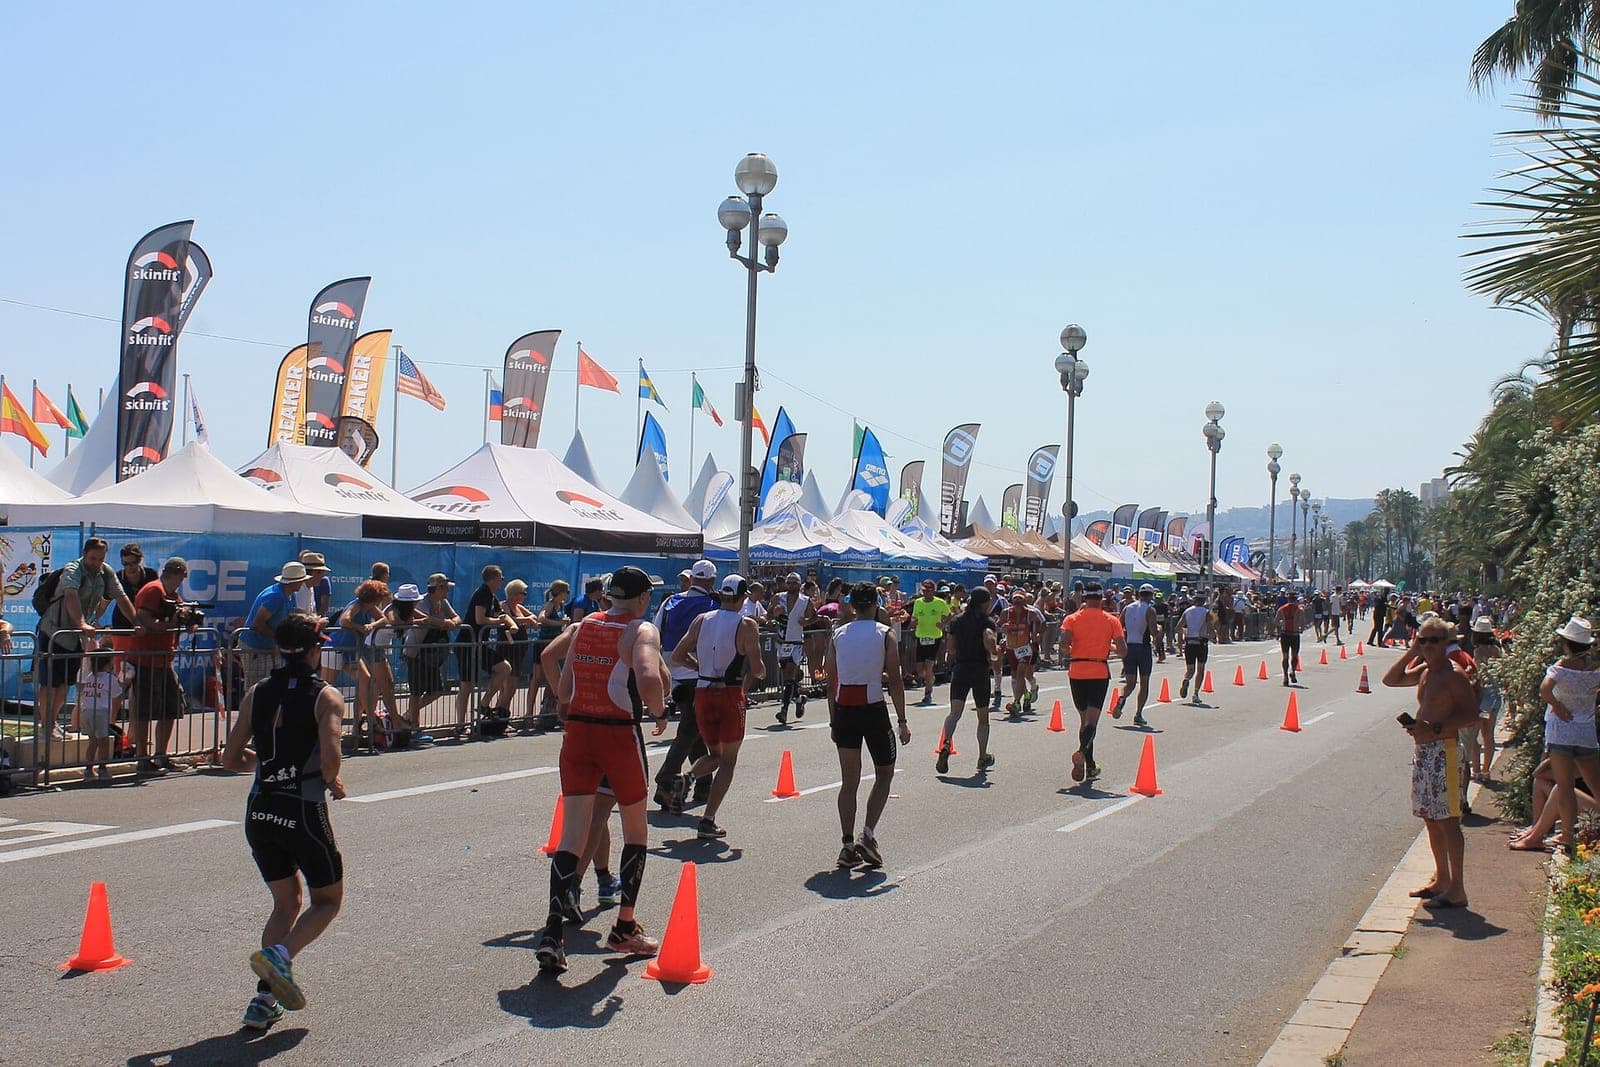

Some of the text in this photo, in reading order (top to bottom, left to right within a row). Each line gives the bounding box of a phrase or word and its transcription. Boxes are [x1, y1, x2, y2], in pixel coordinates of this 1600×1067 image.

[133, 268, 180, 281] skinfit
[312, 314, 356, 329] skinfit
[128, 333, 174, 346] skinfit
[508, 360, 547, 374] skinfit
[308, 370, 345, 384] kinfit
[125, 399, 170, 411] skinfit
[503, 408, 539, 421] skinfit
[307, 426, 336, 440] infit
[122, 462, 154, 476] skin
[335, 489, 390, 503] skinfit
[570, 507, 624, 521] skinfit
[480, 527, 522, 539] TISPORT.
[251, 811, 297, 829] SOPHIE
